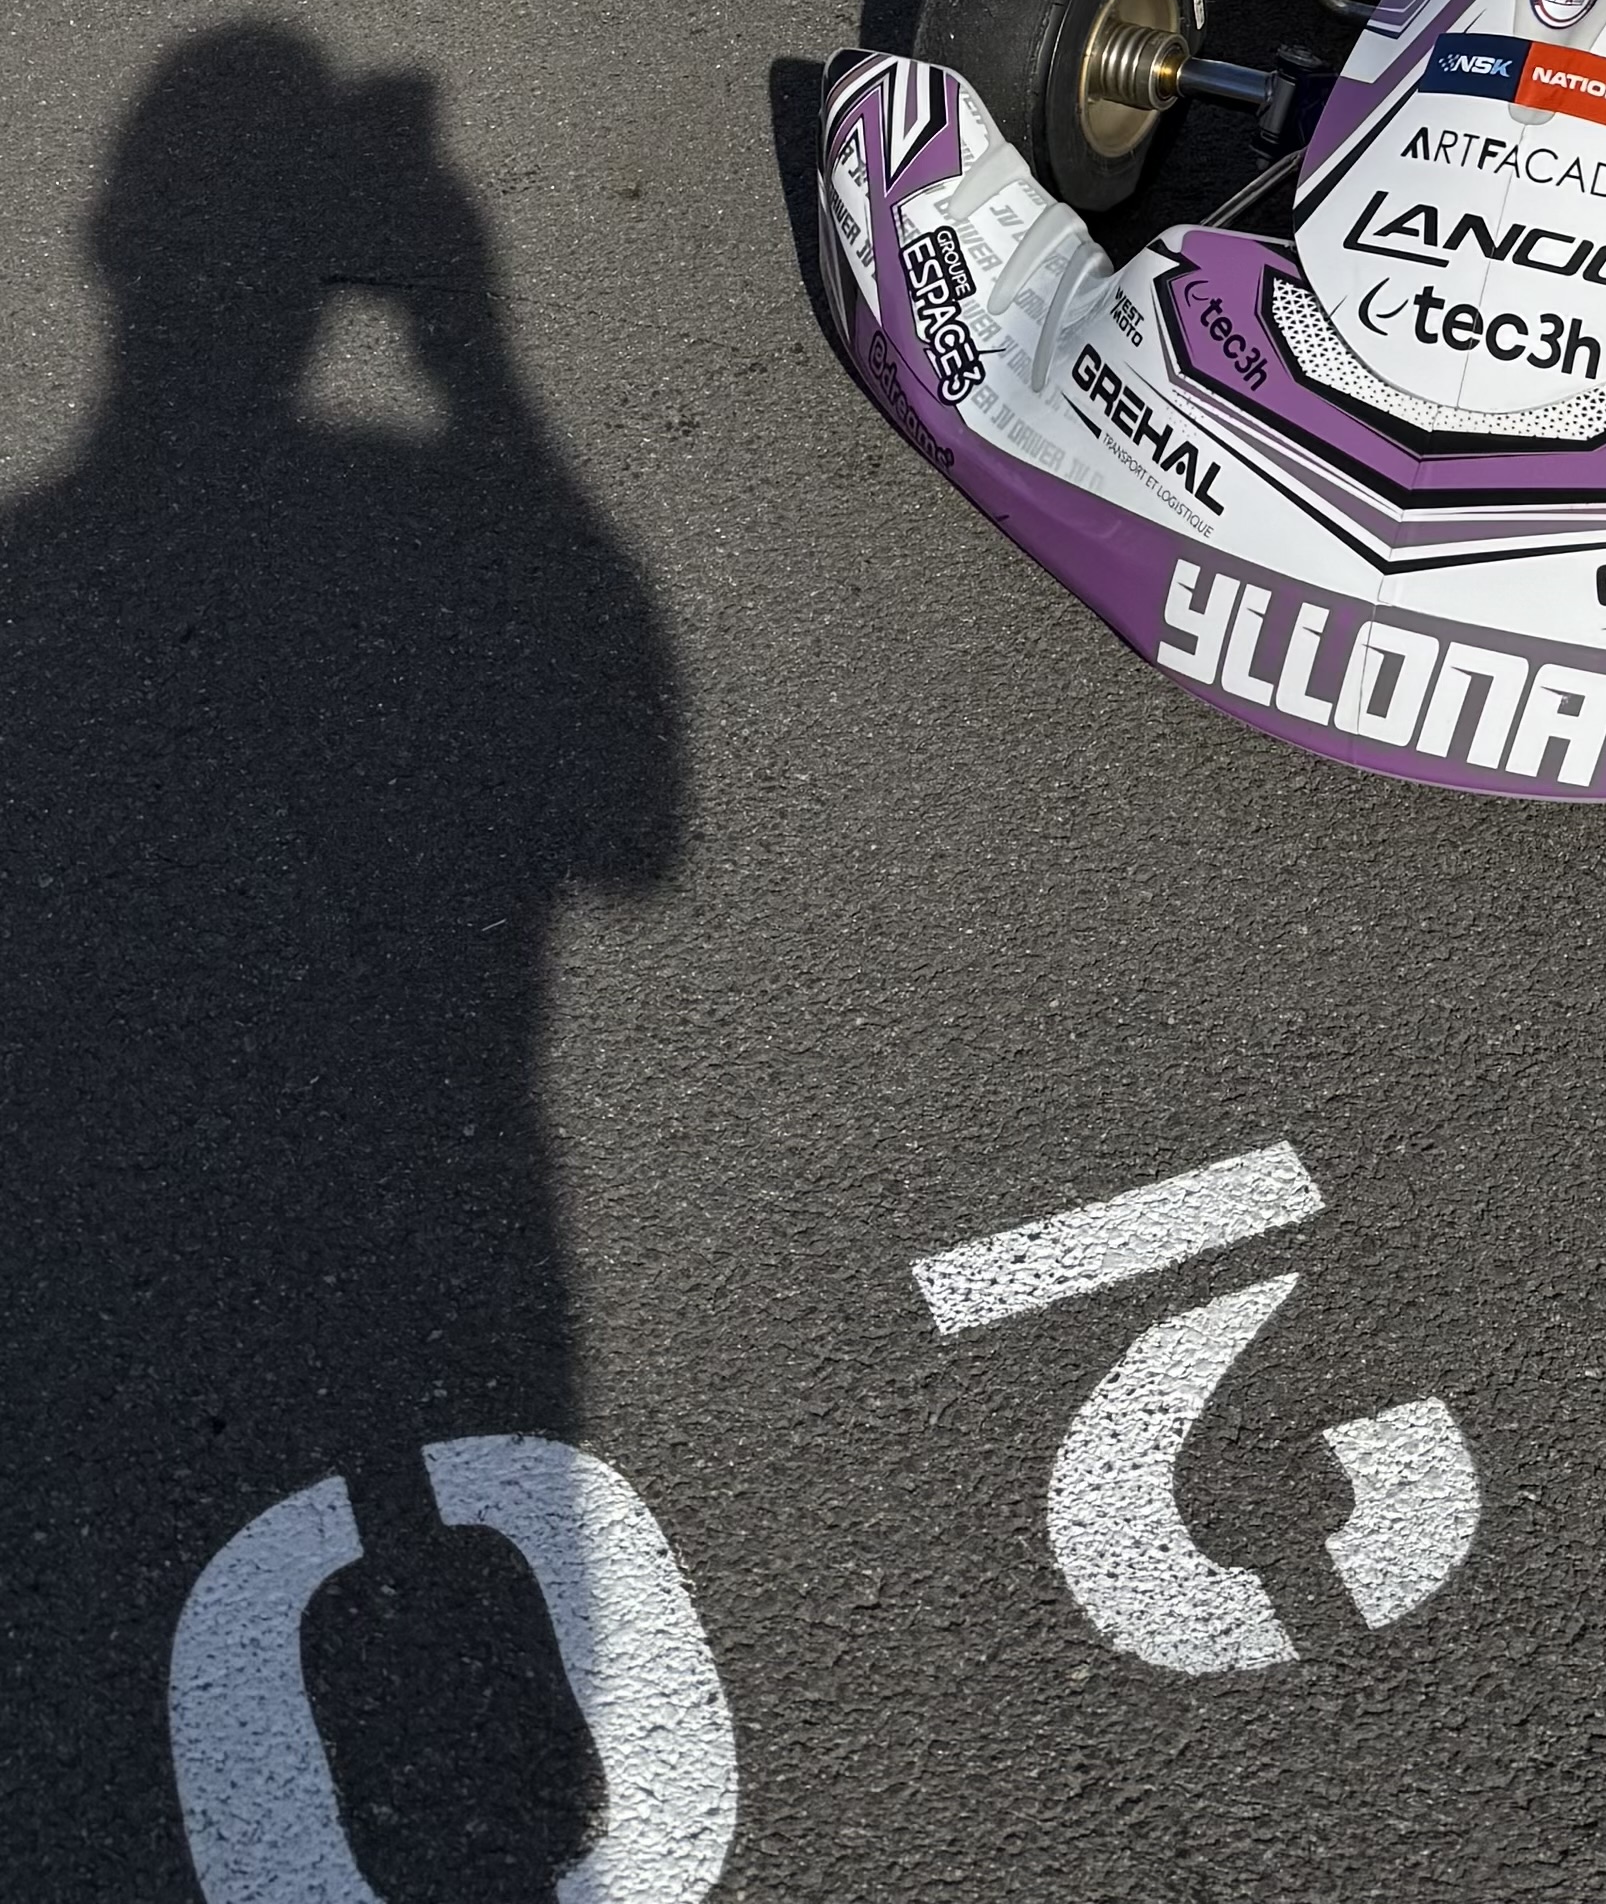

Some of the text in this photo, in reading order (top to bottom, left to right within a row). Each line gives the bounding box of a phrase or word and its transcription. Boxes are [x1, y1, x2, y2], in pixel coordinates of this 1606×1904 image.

[1451, 54, 1515, 79] NSK
[936, 229, 972, 296] GROUPE
[1110, 304, 1144, 348] MOTO
[1113, 285, 1145, 326] WEST
[1199, 296, 1268, 392] tec3h
[1412, 283, 1604, 382] tec3h
[1071, 342, 1225, 517] GREHAL
[1102, 432, 1215, 539] TRANSPORT ET LOGISTIQUE
